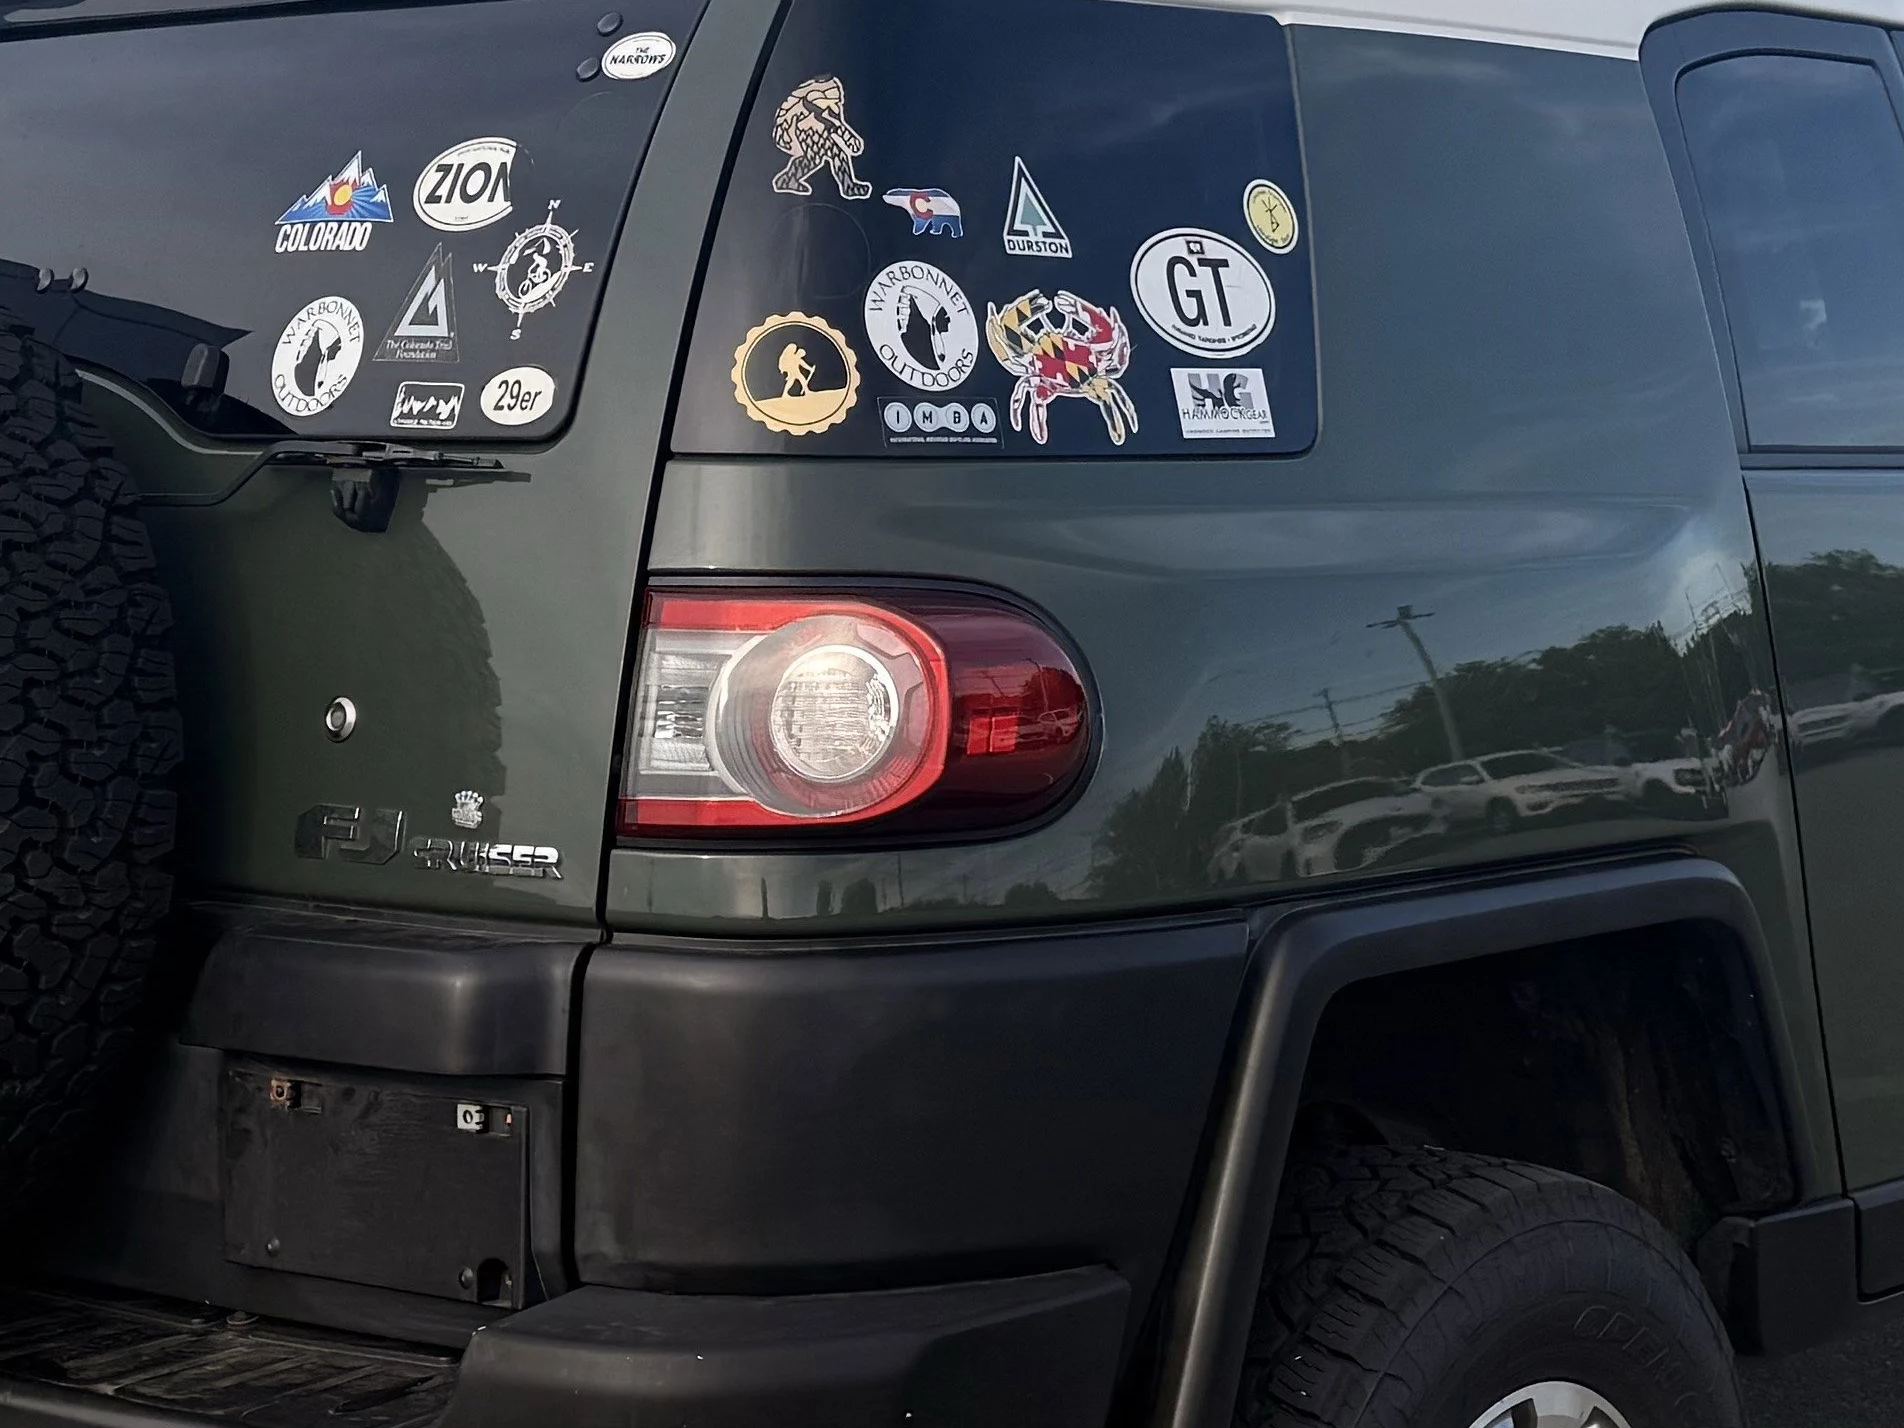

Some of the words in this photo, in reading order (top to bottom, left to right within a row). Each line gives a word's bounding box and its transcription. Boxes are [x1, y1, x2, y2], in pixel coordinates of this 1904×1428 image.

[424, 161, 512, 204] ZION
[548, 199, 562, 210] N
[275, 221, 373, 253] COLORADO
[1007, 239, 1070, 255] DURSTON
[473, 263, 488, 273] W
[583, 262, 595, 273] E
[869, 265, 969, 315] WARBONNET
[1165, 255, 1232, 327] GT
[282, 300, 361, 345] WARBONNET
[509, 328, 522, 341] S
[879, 344, 974, 388] OUTDOORS
[274, 373, 348, 413] OUTDOORS
[493, 379, 543, 412] 29er
[409, 836, 564, 879] CRUISER
